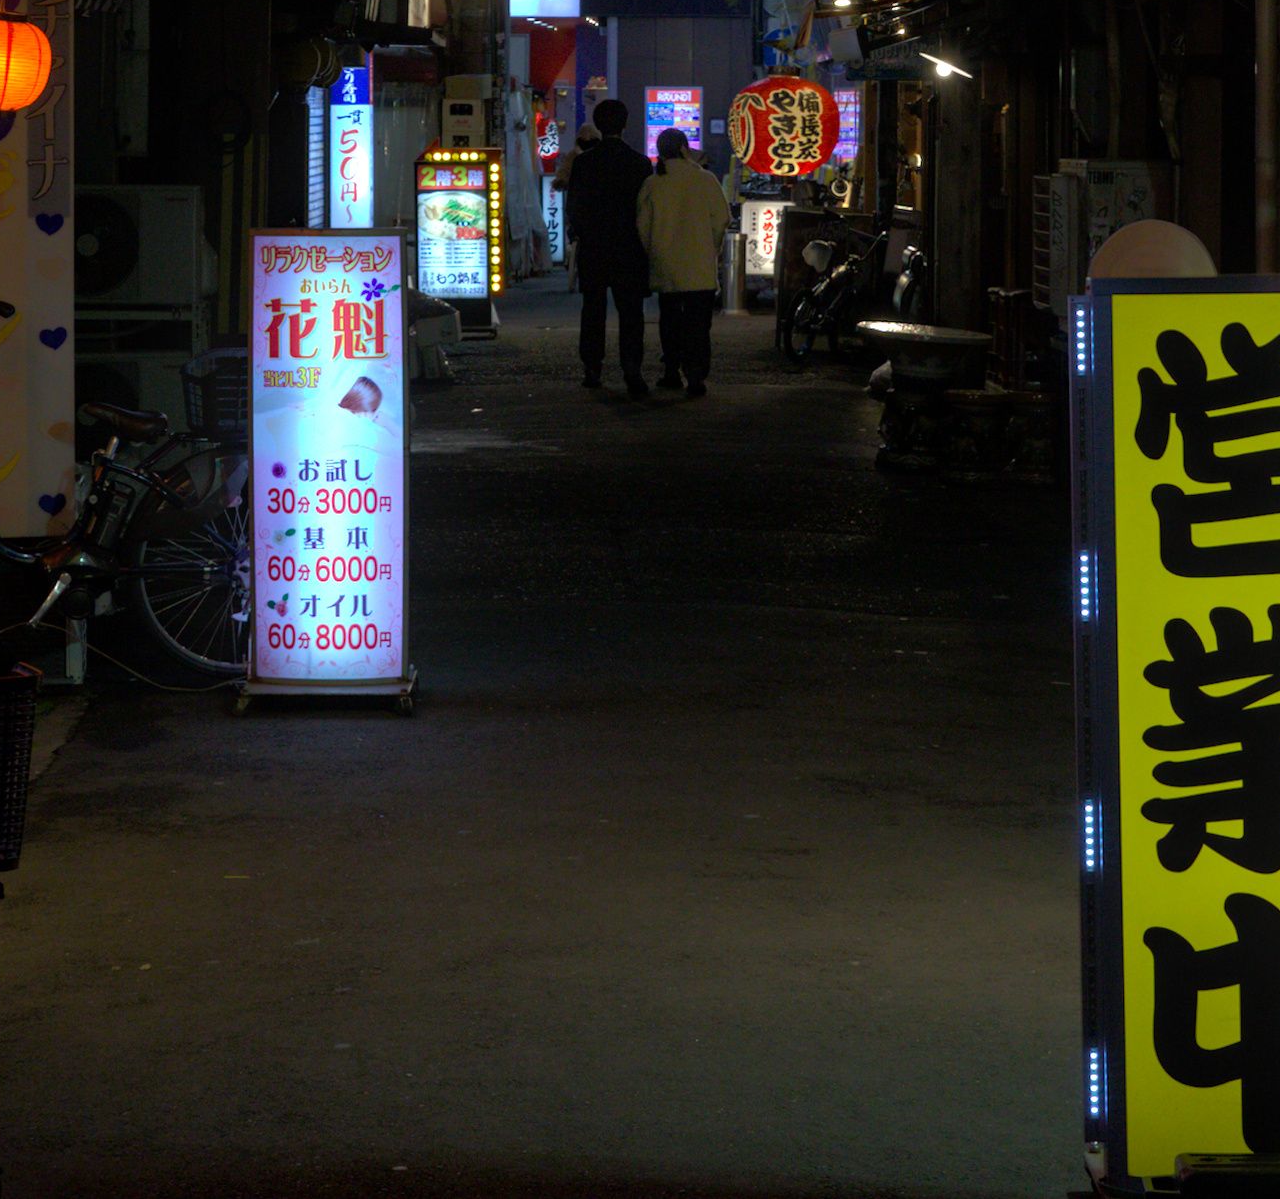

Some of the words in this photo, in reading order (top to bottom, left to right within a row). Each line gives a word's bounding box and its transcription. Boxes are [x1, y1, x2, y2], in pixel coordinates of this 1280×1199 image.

[770, 90, 795, 174] やきとり
[796, 90, 820, 160] 備長炭
[421, 166, 483, 187] 2階・3階
[261, 245, 393, 273] リラクゼーション
[300, 277, 352, 294] おいらん
[264, 298, 389, 360] 花魁
[298, 459, 373, 482] お試し
[267, 488, 310, 514] 30分
[315, 488, 392, 514] 3000円
[303, 527, 369, 550] 基本
[267, 556, 310, 582] 60分
[315, 556, 392, 582] 6000円
[300, 594, 373, 617] オイル
[268, 624, 311, 650] 60分
[316, 624, 392, 650] 8000円
